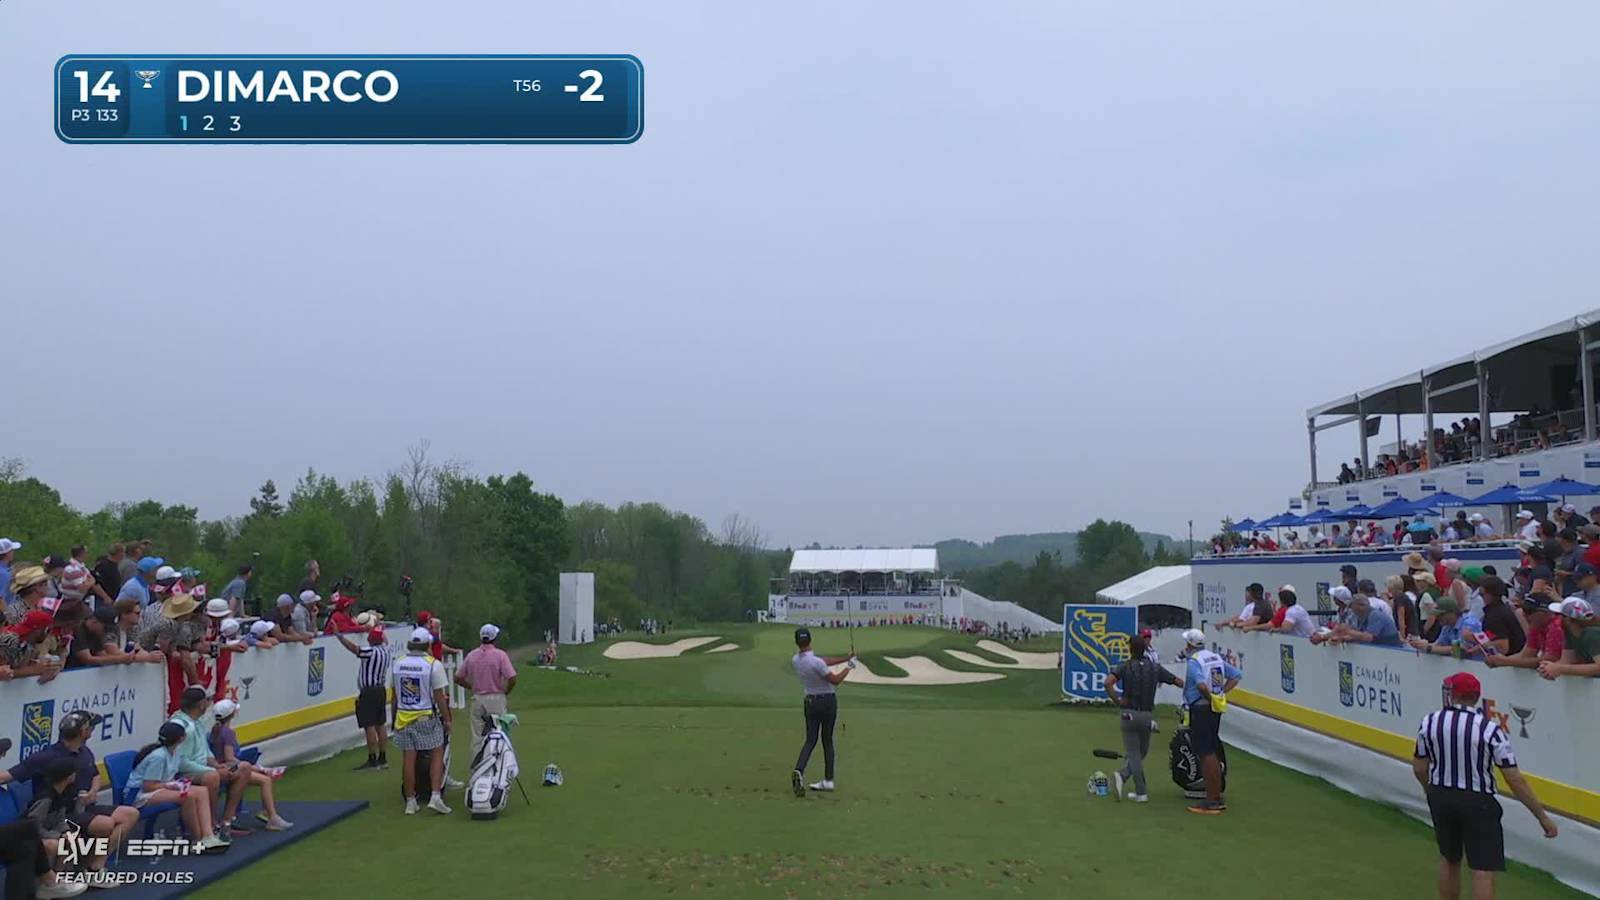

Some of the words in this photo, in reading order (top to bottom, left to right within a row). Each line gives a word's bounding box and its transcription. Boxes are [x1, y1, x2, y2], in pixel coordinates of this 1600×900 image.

[1355, 664, 1401, 686] CANADIAN
[61, 683, 137, 714] CANADIAN
[1356, 684, 1402, 717] OPEN
[101, 709, 135, 741] EN
